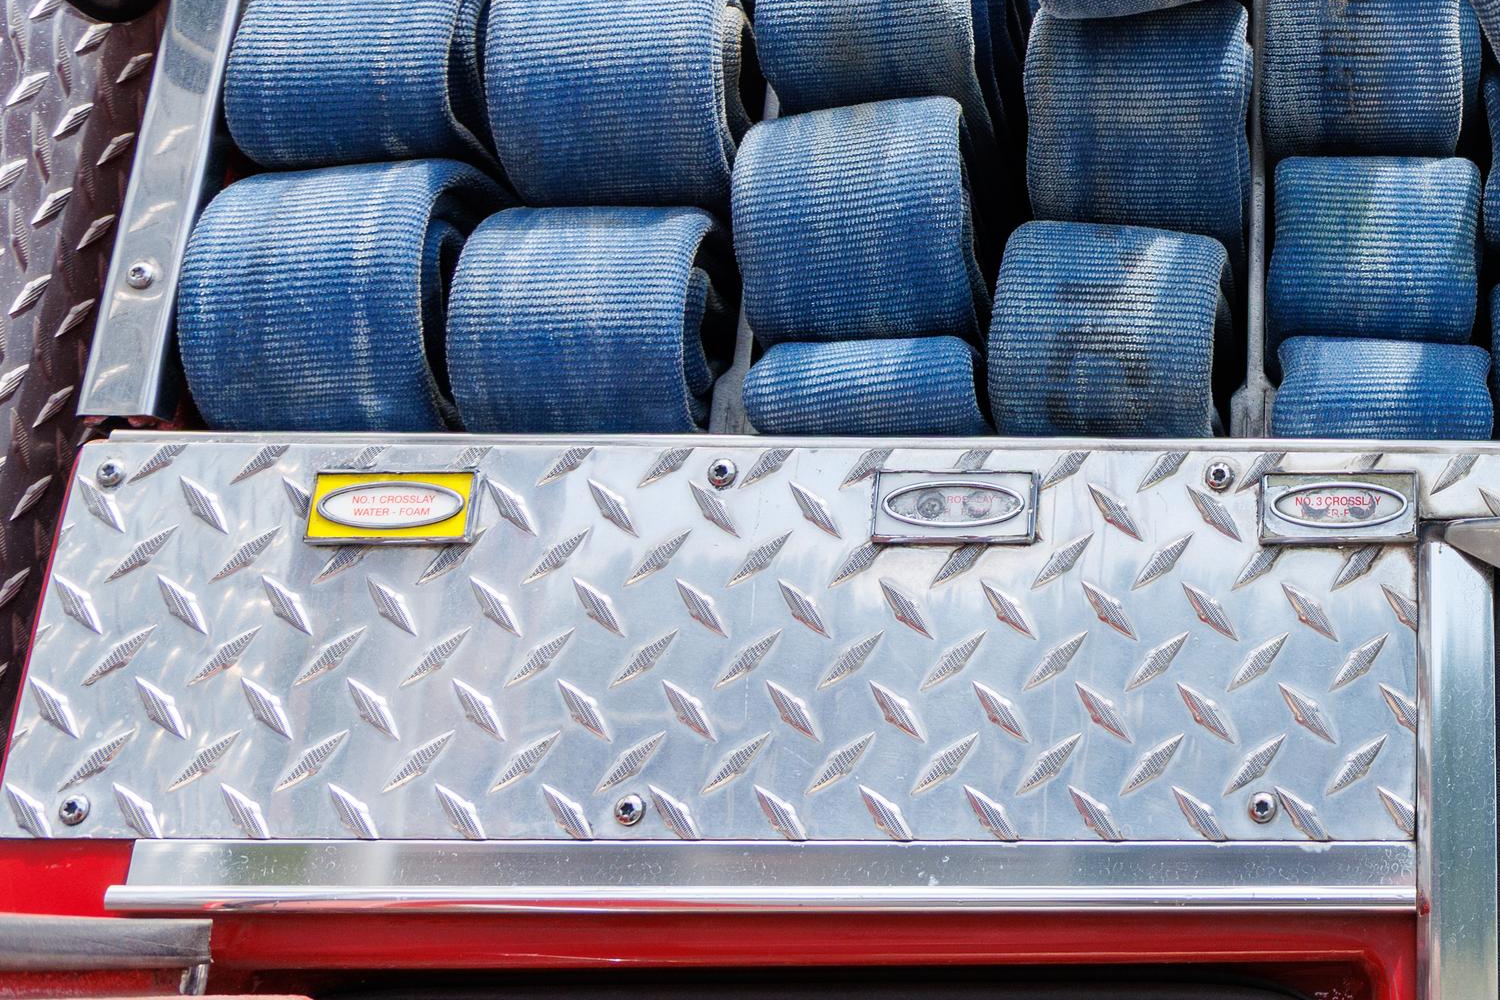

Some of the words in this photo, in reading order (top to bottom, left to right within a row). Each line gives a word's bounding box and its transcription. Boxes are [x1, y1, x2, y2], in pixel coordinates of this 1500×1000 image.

[380, 495, 435, 504] CROSSLAY
[1325, 497, 1381, 506] CROSSLAY
[354, 508, 389, 516] WATER
[400, 508, 429, 516] FOAM
